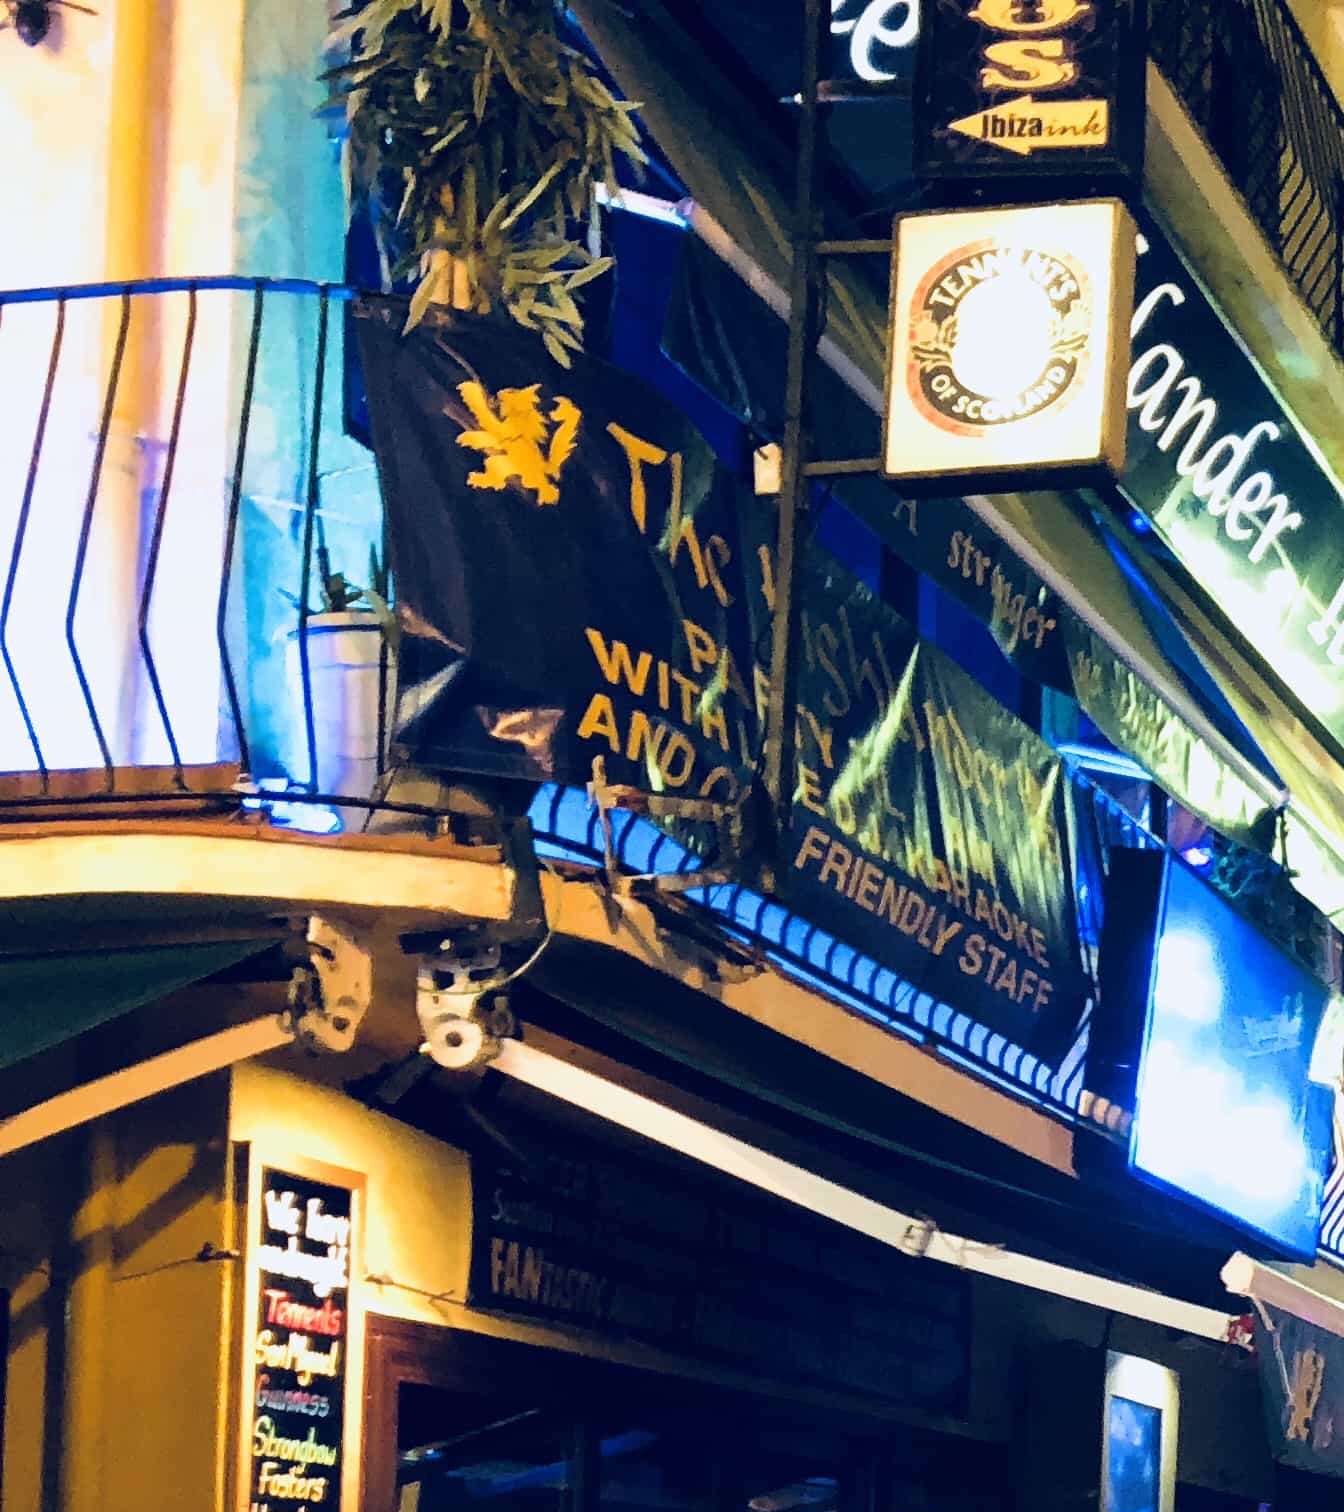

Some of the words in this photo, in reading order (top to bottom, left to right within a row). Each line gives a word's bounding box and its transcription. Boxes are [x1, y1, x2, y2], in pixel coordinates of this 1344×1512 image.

[981, 114, 1042, 139] Ibiza
[1044, 110, 1104, 136] ink
[929, 248, 1079, 306] TENNNT'S
[952, 365, 1067, 421] SCOAND
[584, 626, 730, 752] WITH
[576, 692, 696, 790] AND
[795, 826, 962, 957] FRIENDLY
[958, 933, 1053, 1012] STAFF
[252, 1416, 336, 1473] Strongbow
